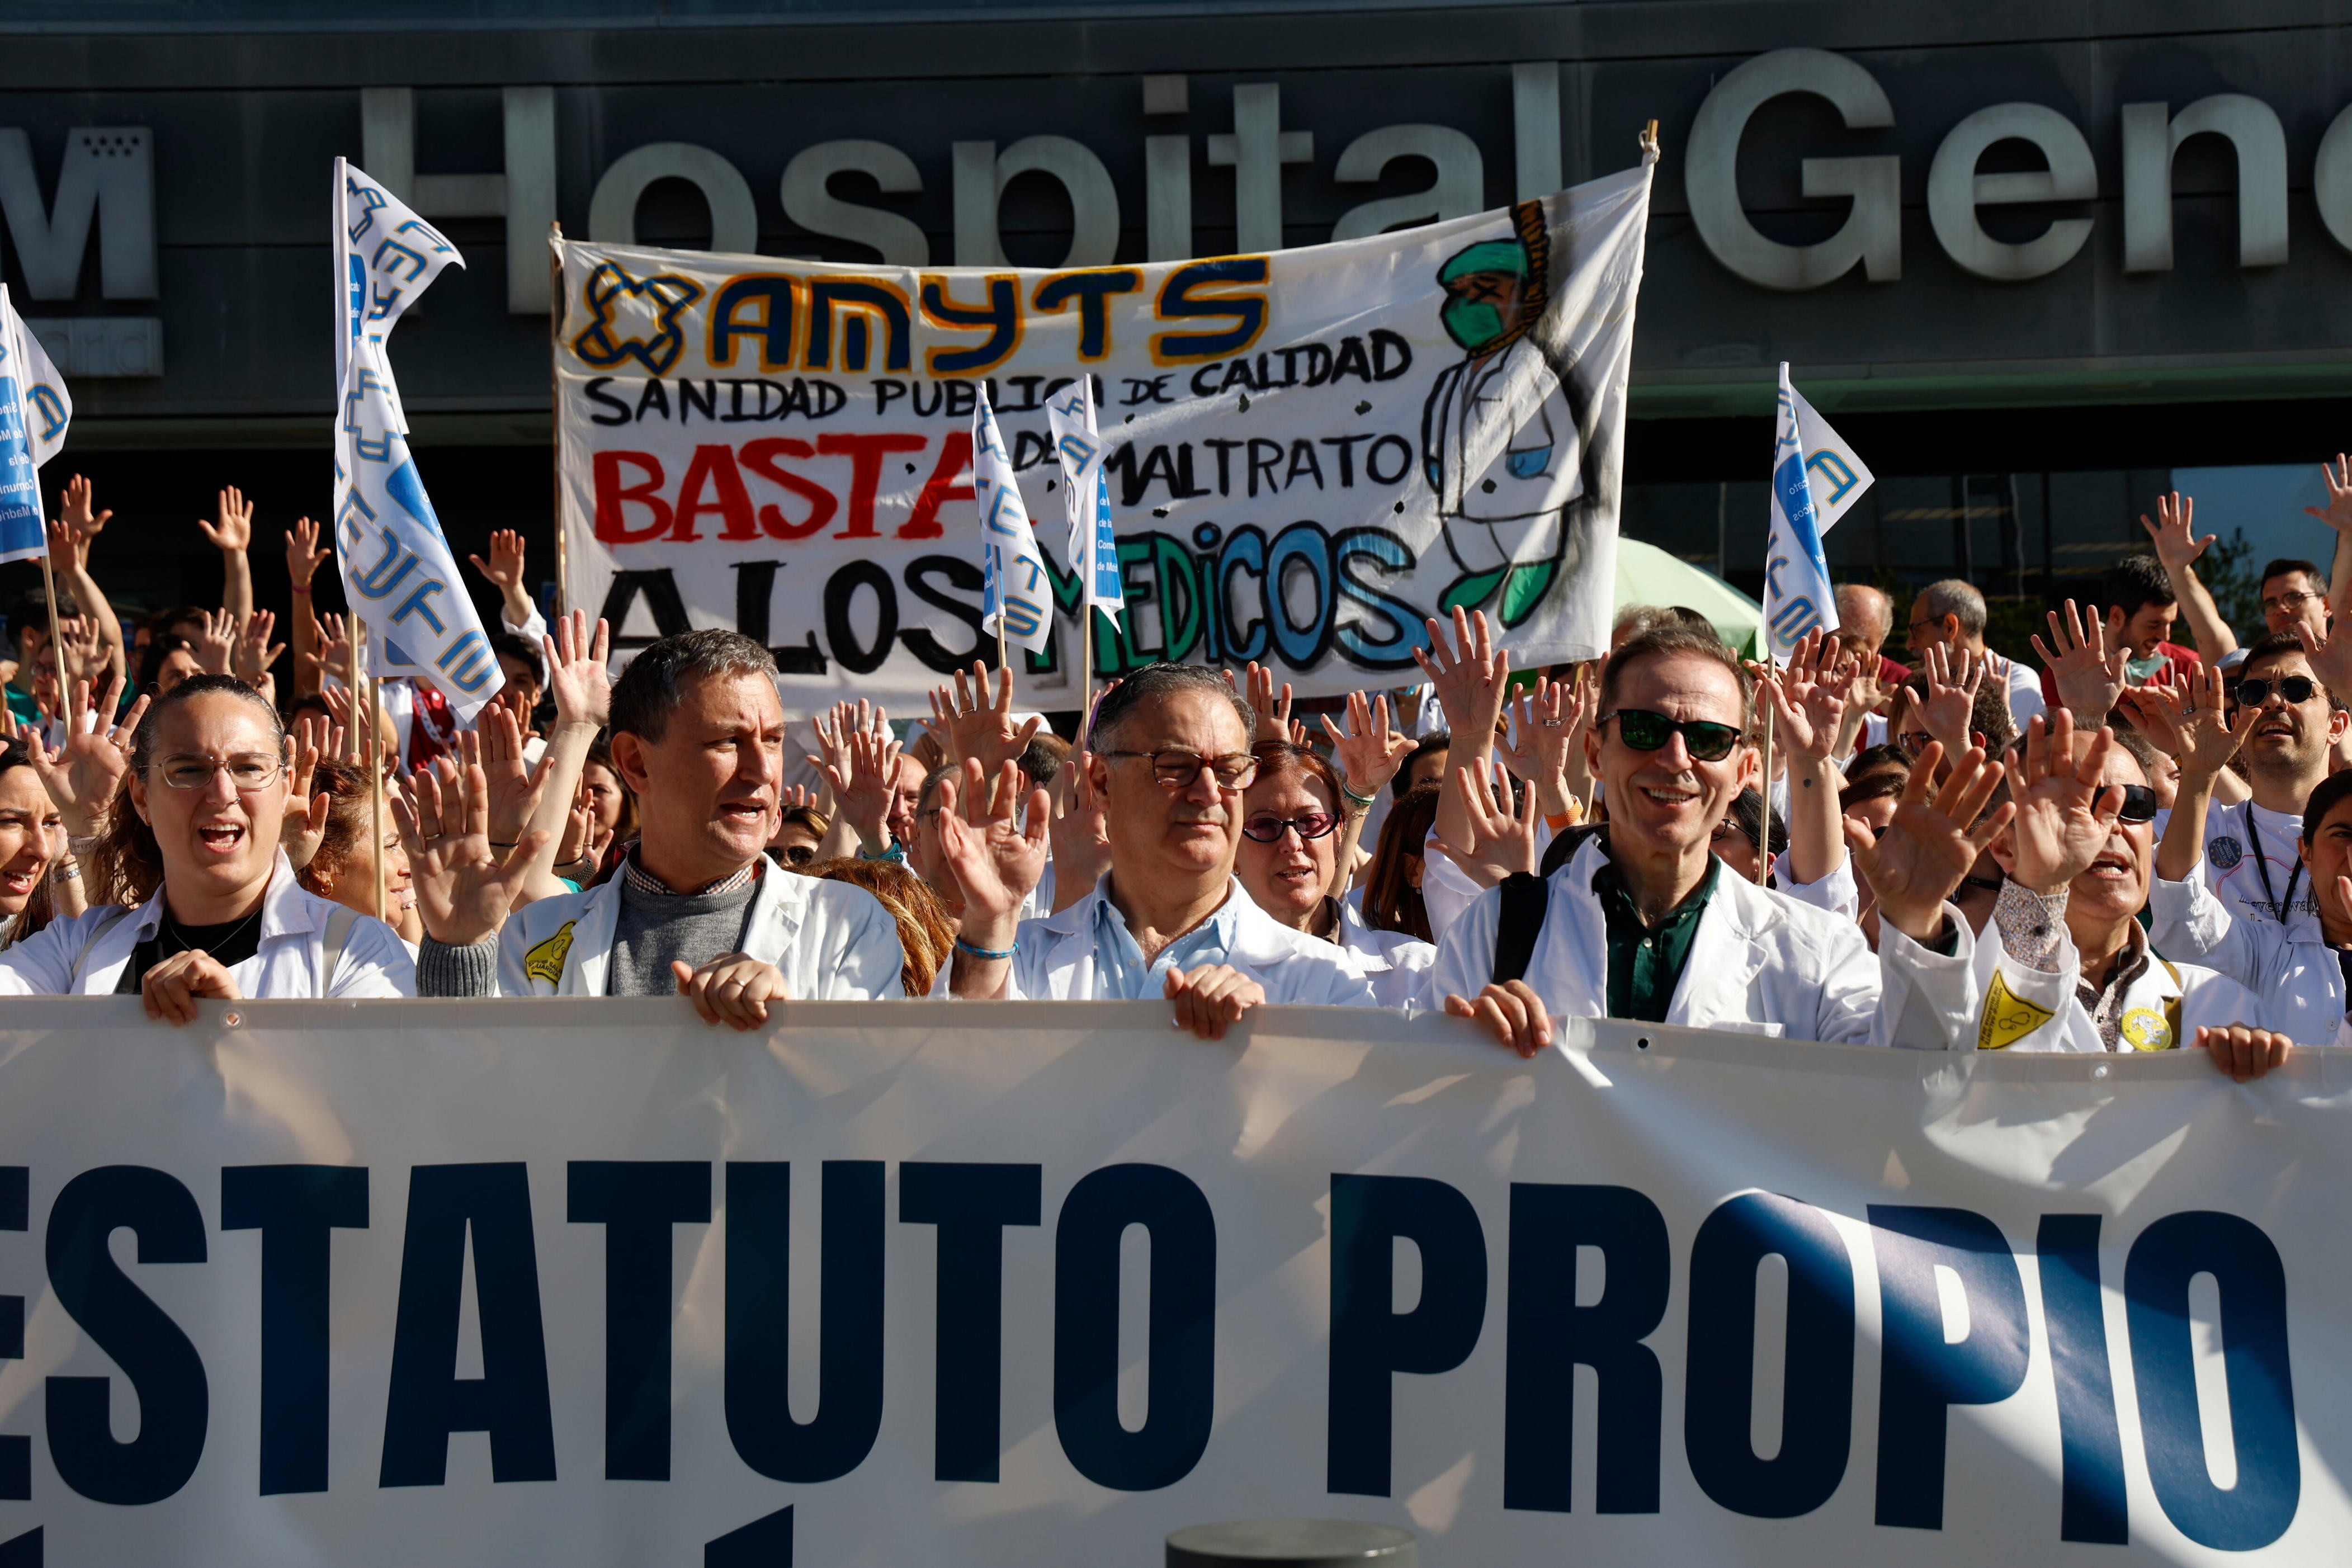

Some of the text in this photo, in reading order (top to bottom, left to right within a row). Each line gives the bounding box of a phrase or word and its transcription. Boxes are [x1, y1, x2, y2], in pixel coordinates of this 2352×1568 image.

[361, 48, 2352, 315] Hospital Gen
[584, 377, 847, 426] SANIDAD
[1120, 373, 1175, 405] DE
[1190, 329, 1413, 397] CALIDAD
[706, 255, 1271, 379] AMYTS
[591, 431, 1037, 544] BASTA
[1101, 433, 1413, 507] MALTRATO
[1327, 1172, 2302, 1552] PROPIO
